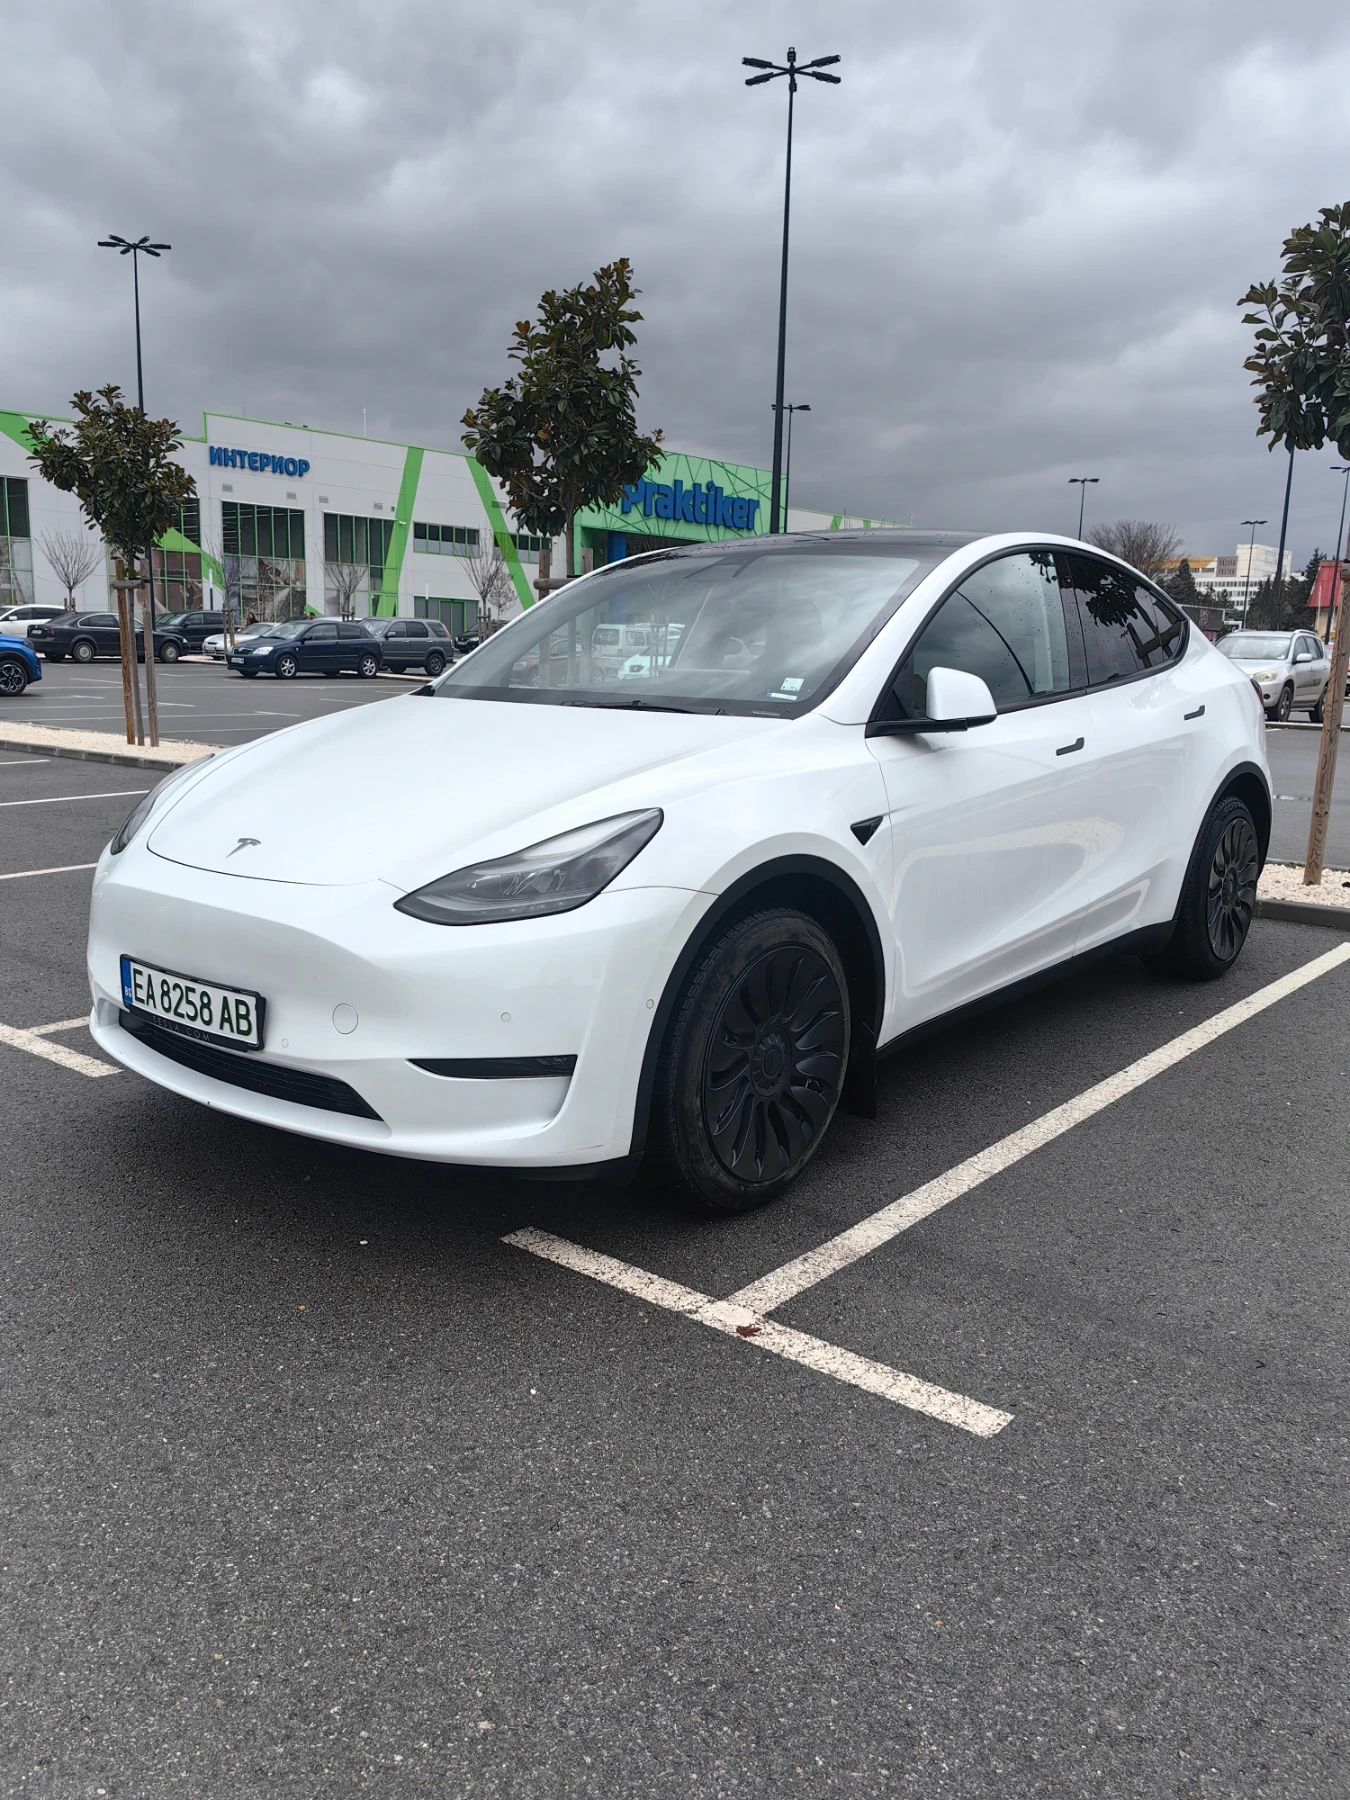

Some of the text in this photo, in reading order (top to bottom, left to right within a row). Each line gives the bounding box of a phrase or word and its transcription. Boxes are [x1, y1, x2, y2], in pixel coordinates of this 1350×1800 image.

[209, 445, 310, 477] ИНТЕРИОР
[621, 477, 760, 531] Praktiker
[124, 985, 132, 998] BG
[132, 967, 252, 1037] EA 8258 AB
[152, 1015, 211, 1042] TESLA.COM
